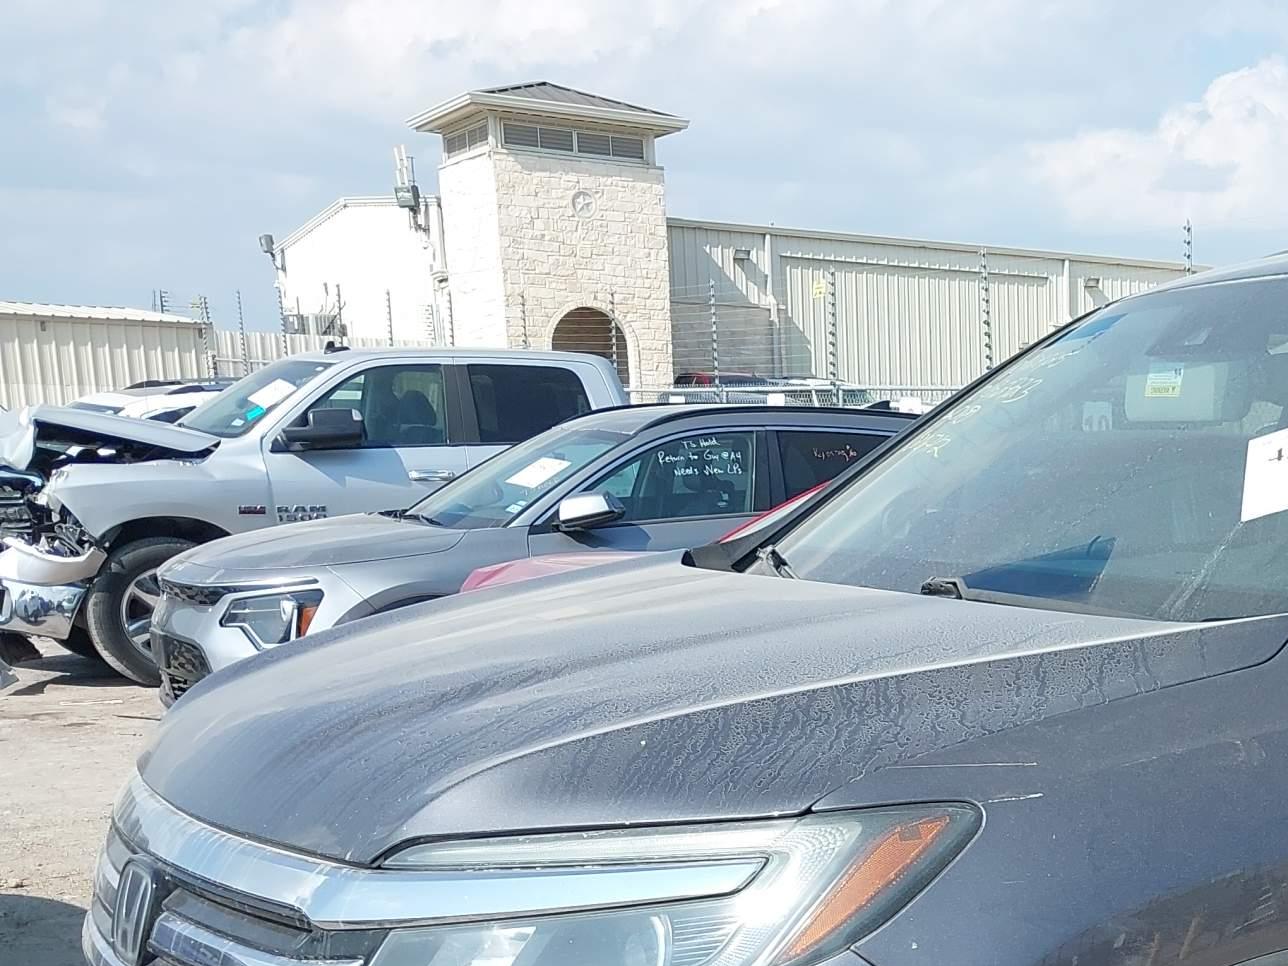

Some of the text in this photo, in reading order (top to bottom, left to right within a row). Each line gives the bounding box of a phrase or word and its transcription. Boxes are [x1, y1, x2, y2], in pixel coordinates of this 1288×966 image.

[657, 450, 685, 465] Return
[688, 452, 699, 461] to
[276, 505, 327, 513] RAM
